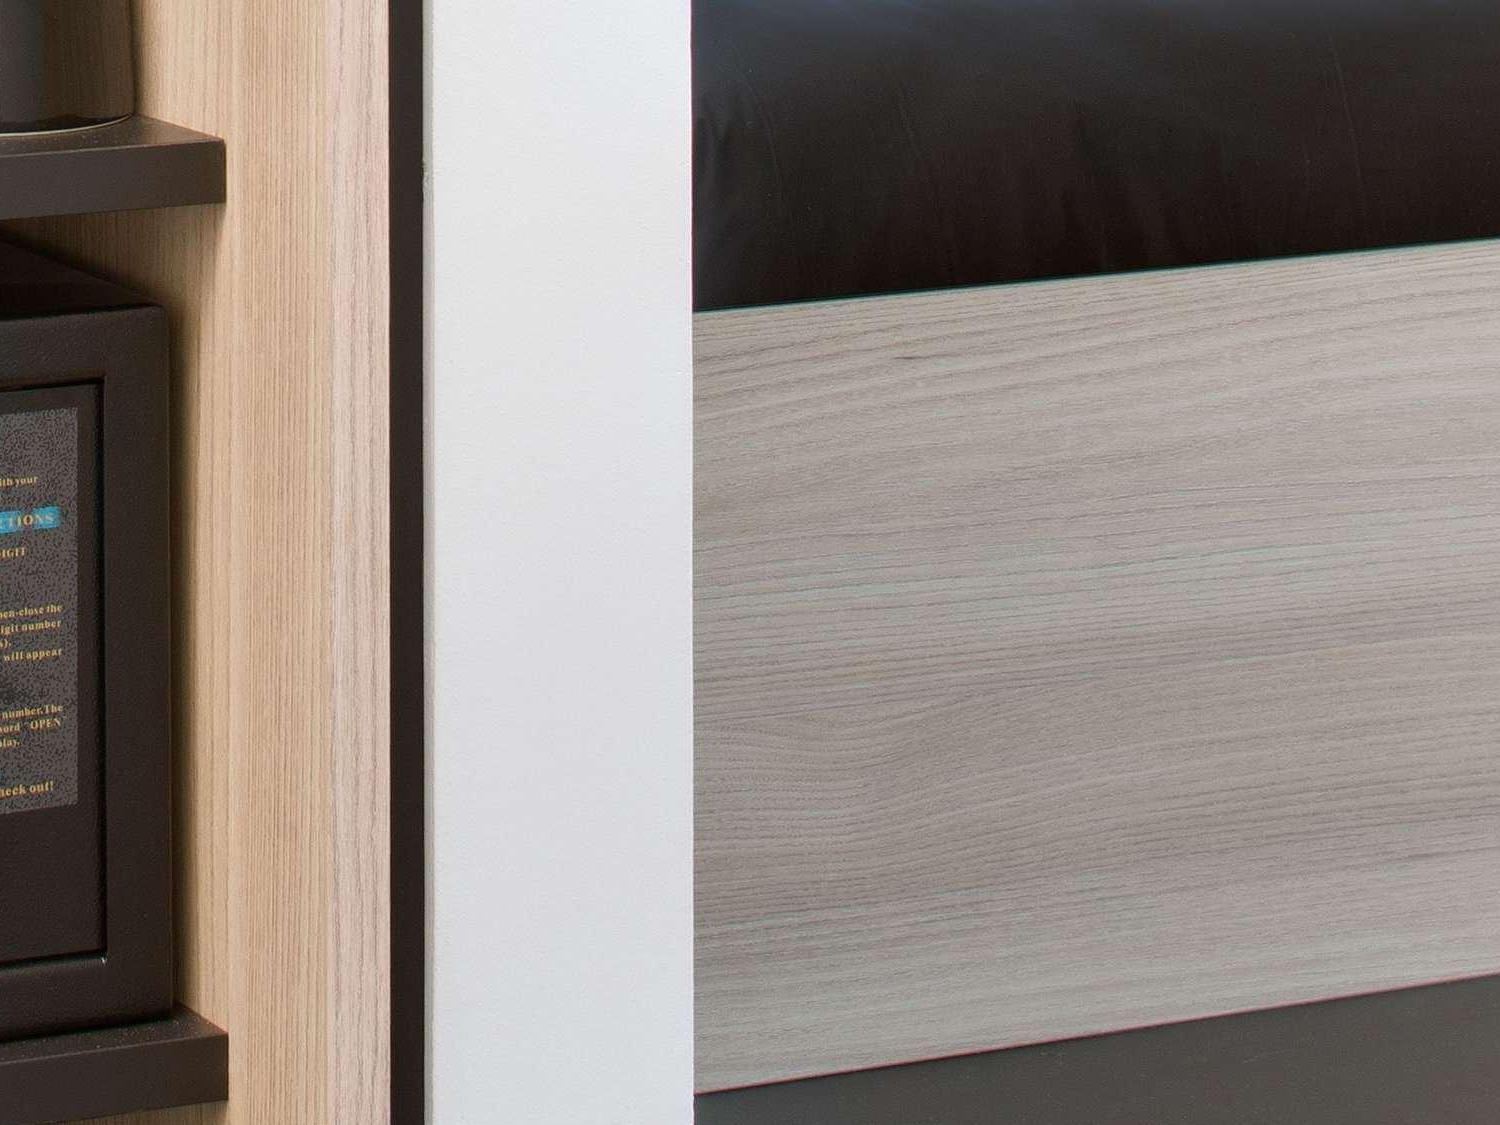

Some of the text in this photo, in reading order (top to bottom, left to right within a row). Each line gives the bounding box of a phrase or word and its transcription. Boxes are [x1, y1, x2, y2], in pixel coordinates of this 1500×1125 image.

[14, 475, 38, 489] your
[46, 603, 62, 613] the
[21, 619, 62, 632] number
[3, 650, 24, 661] will
[25, 648, 63, 661] appear
[29, 780, 54, 793] out!
